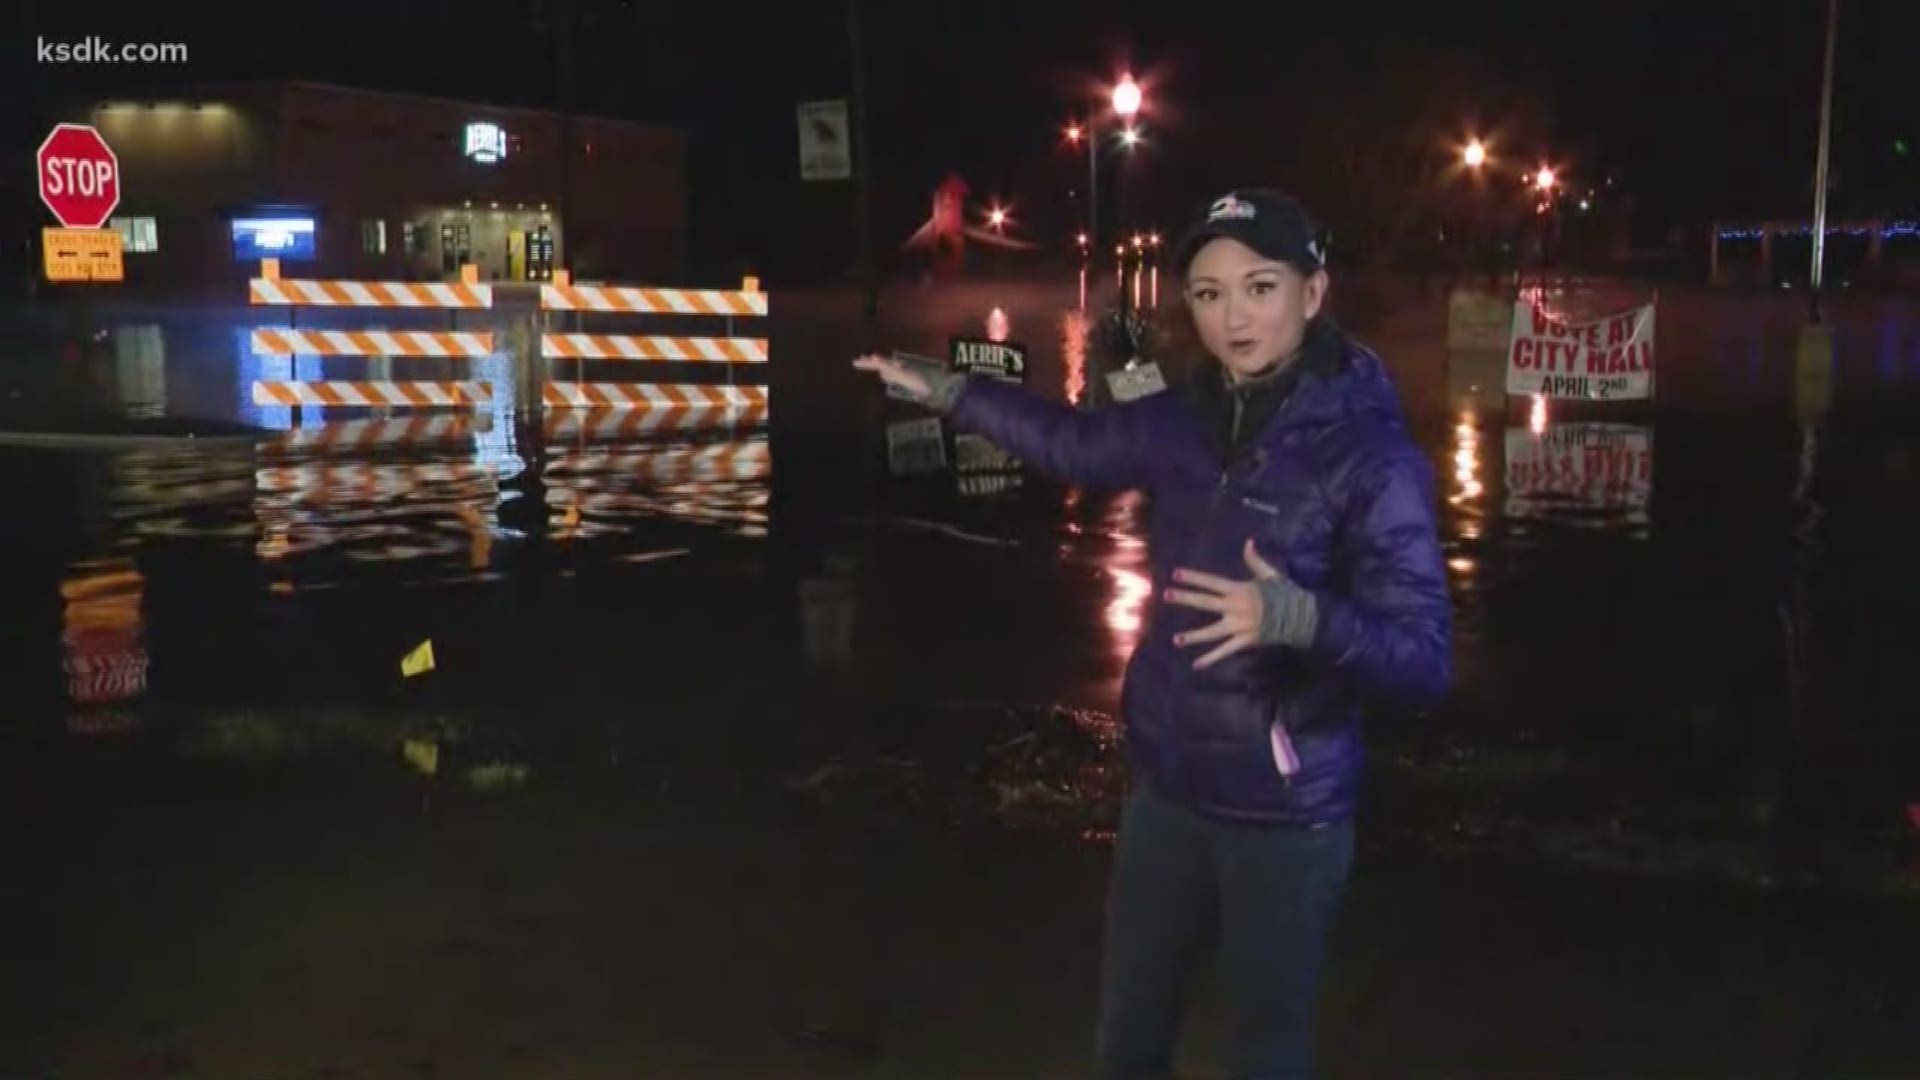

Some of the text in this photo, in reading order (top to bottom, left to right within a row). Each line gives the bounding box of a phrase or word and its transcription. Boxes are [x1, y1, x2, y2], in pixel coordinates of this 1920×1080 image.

[46, 156, 113, 197] STOP
[956, 341, 1025, 372] AERIE'S
[1513, 336, 1580, 373] CITY
[1542, 377, 1589, 397] APRIL
